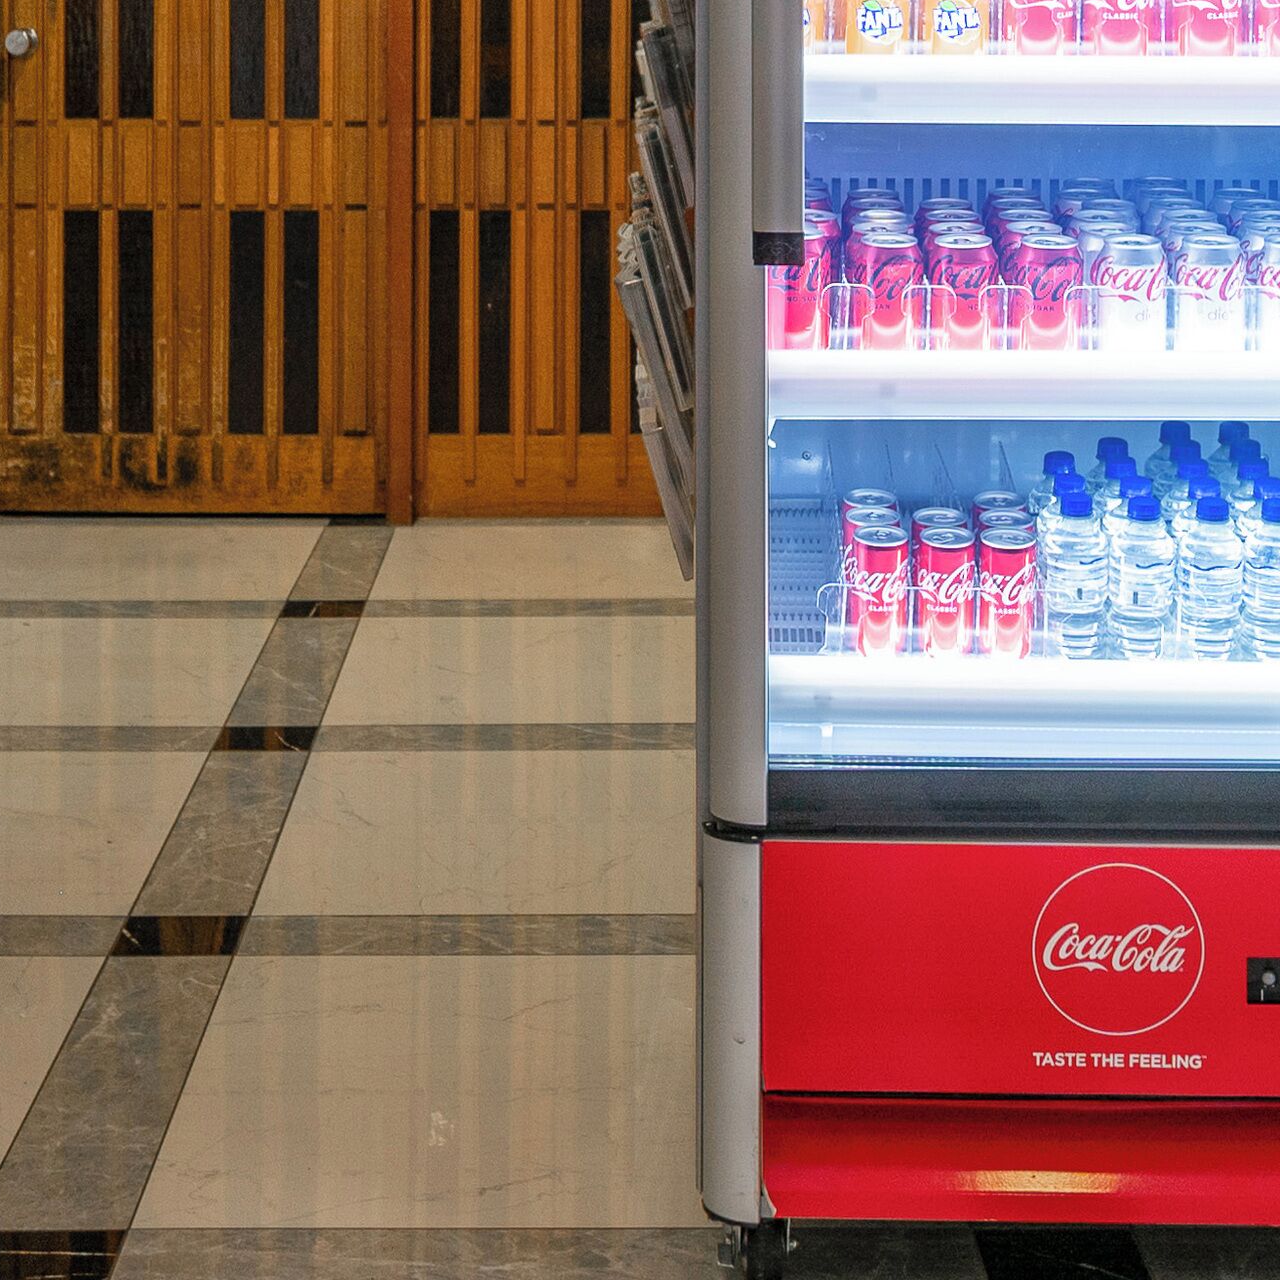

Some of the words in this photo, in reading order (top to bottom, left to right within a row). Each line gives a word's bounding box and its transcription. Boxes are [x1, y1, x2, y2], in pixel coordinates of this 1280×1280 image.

[1103, 12, 1138, 20] CLASSIC
[1043, 923, 1194, 972] Coca-Cola
[1033, 1052, 1086, 1067] TASTE
[1091, 1053, 1125, 1068] THE
